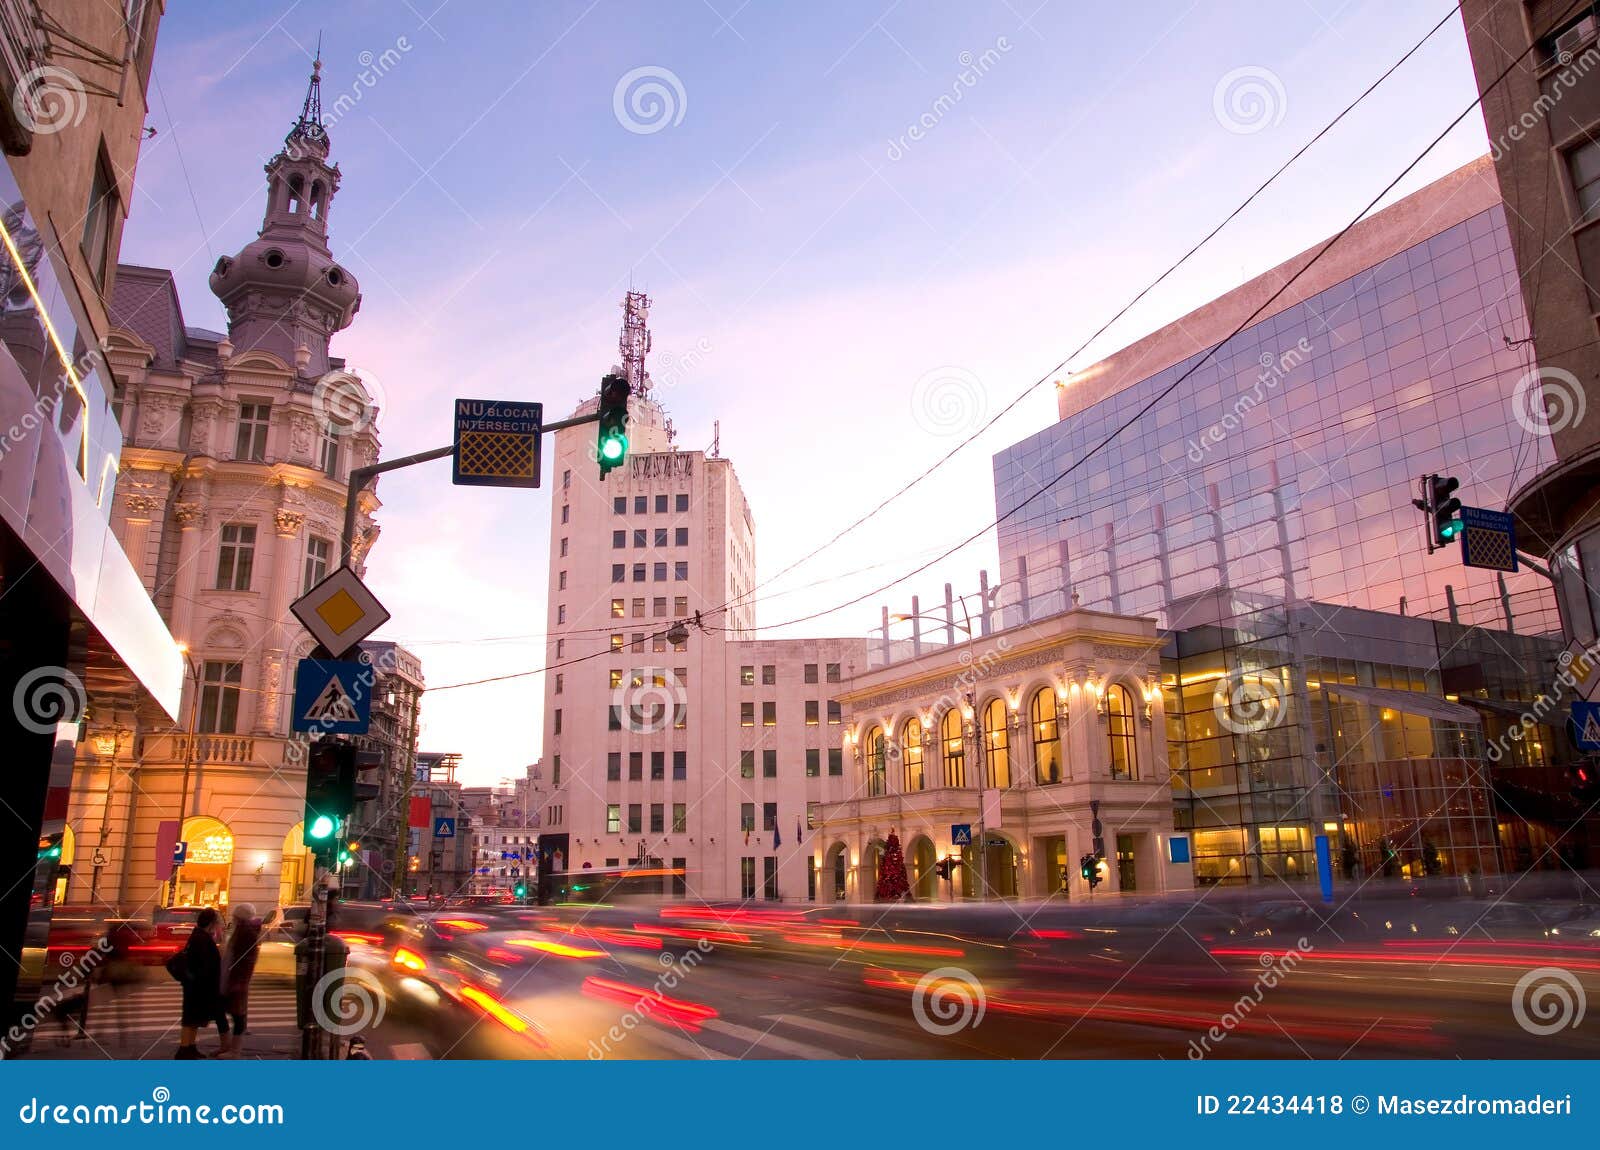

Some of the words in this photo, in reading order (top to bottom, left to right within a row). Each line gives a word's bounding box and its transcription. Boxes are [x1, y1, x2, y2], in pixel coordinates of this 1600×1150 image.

[458, 402, 484, 416] NU
[487, 407, 539, 419] BLOCATI
[457, 420, 539, 431] INTERSECTIA
